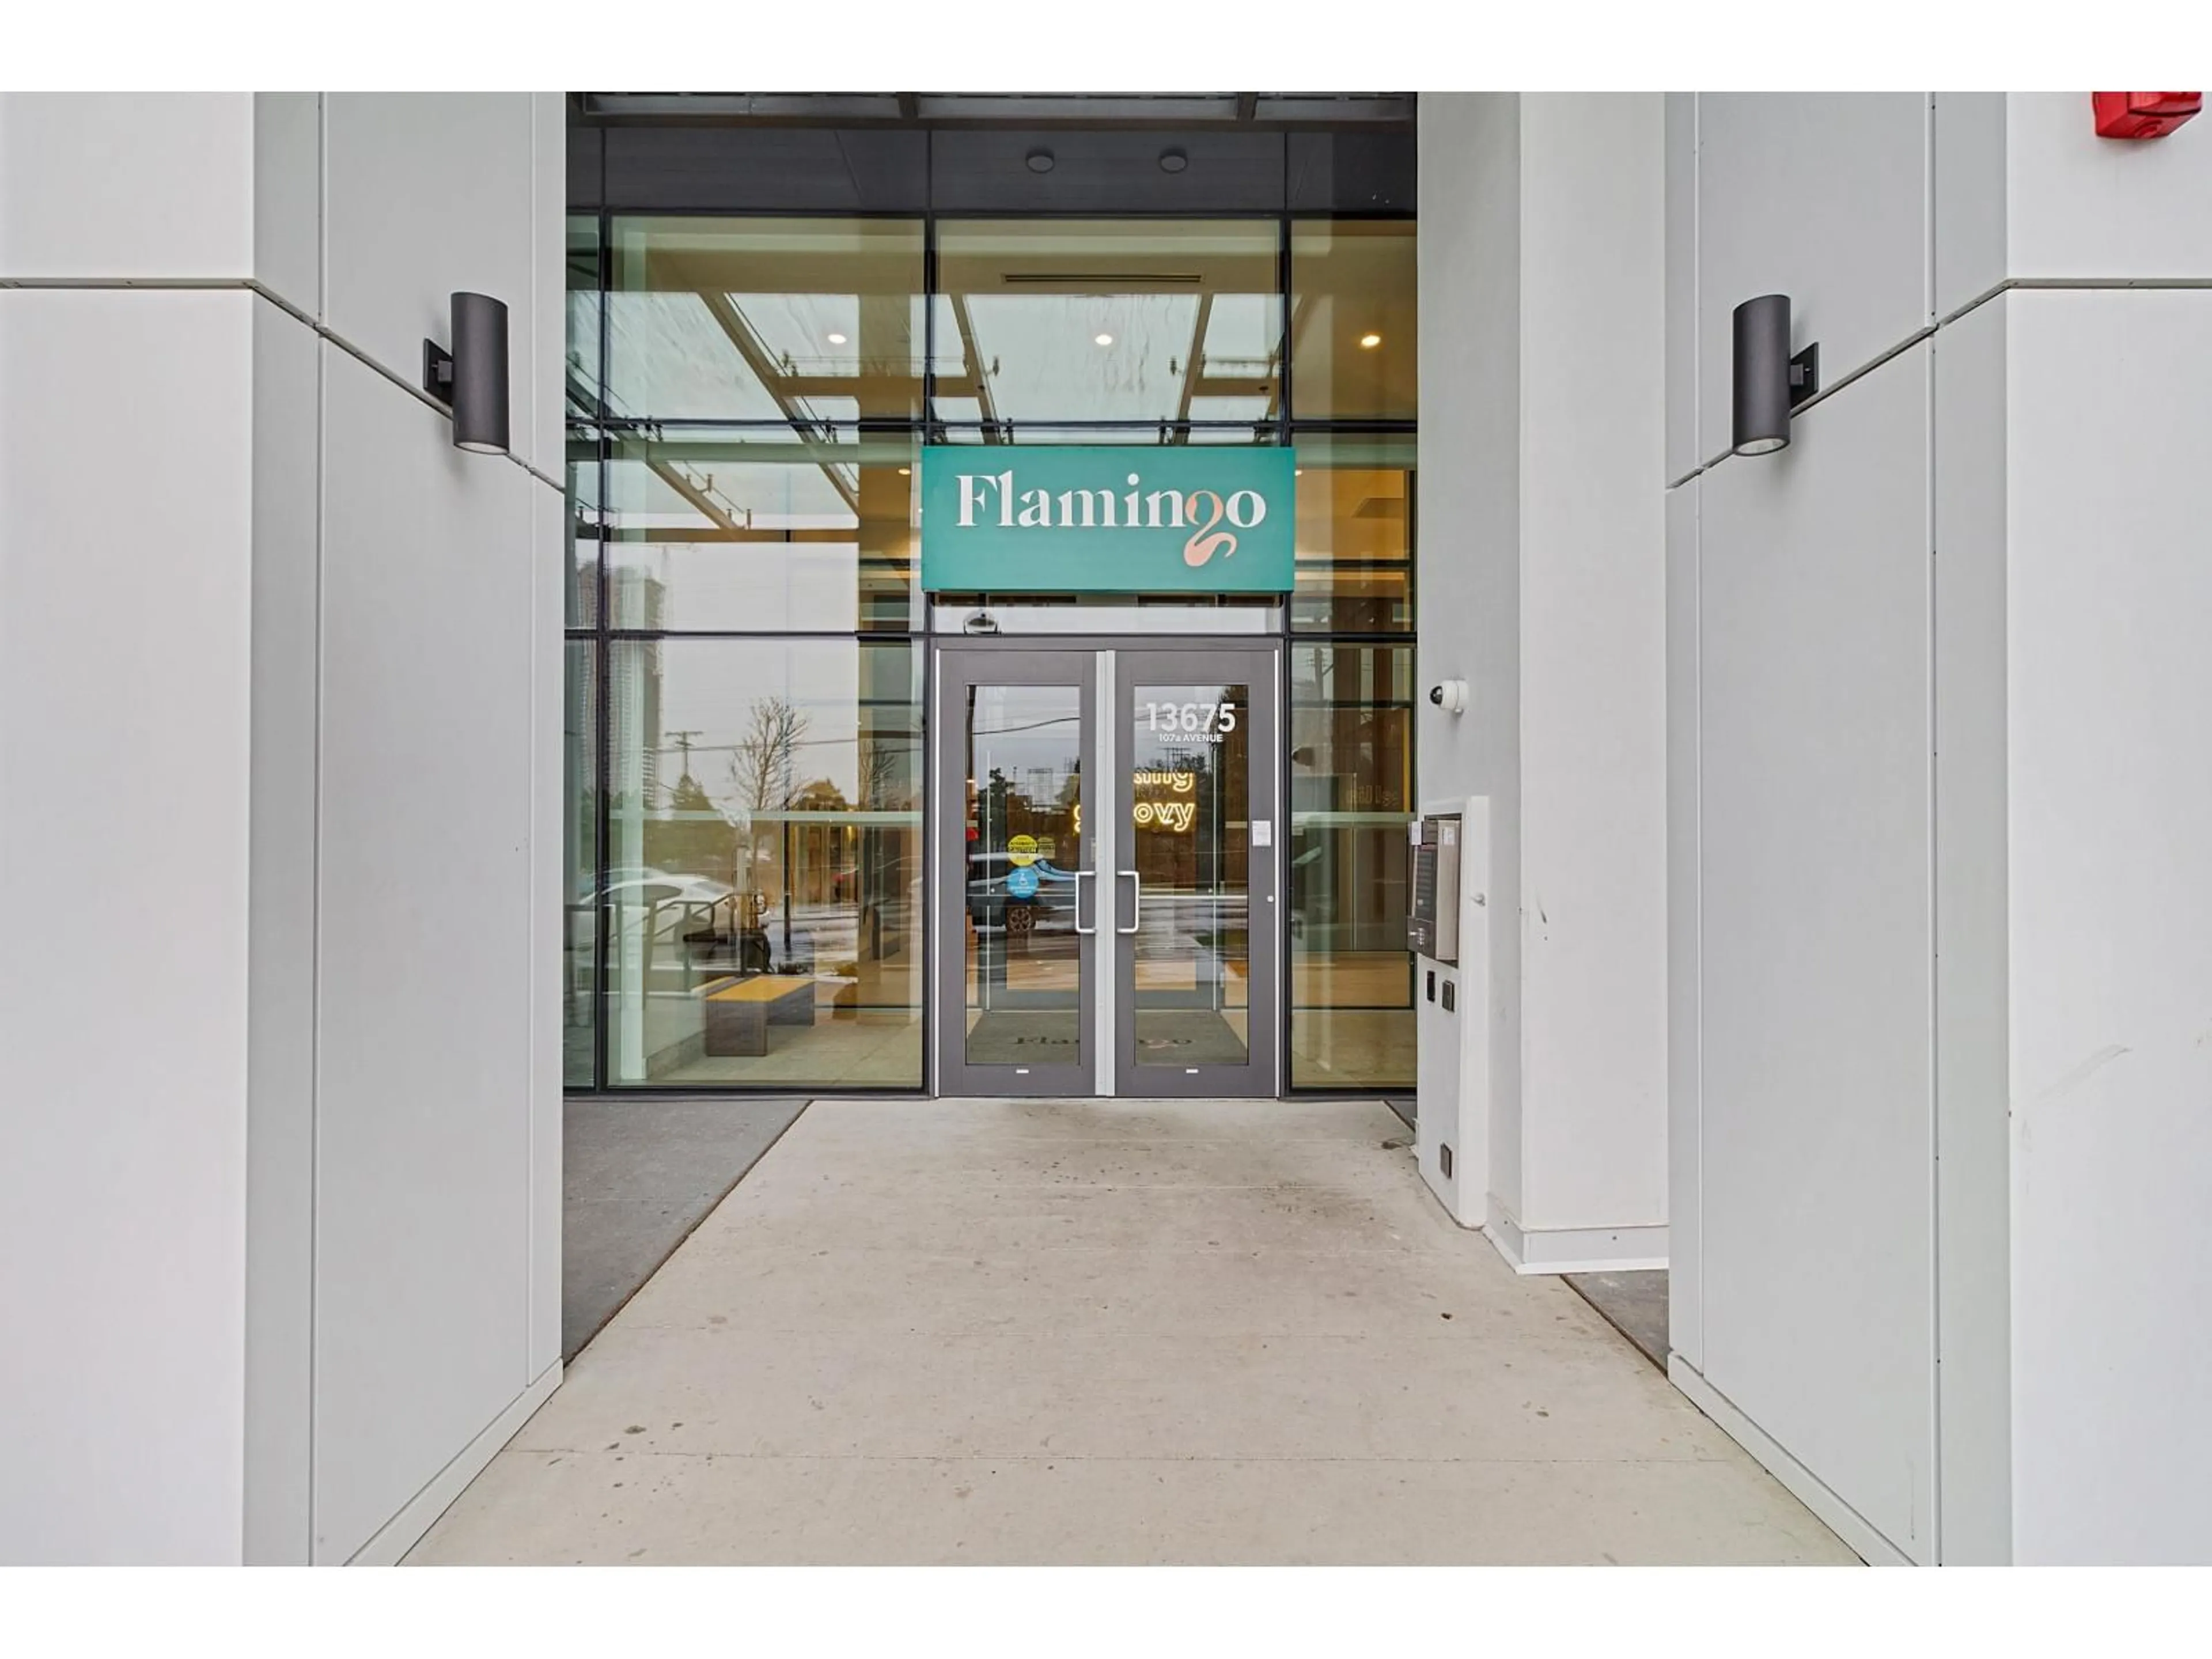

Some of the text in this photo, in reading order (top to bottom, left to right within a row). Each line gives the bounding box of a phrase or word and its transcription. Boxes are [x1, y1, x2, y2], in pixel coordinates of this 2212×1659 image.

[955, 470, 1266, 566] Flamingo
[1146, 702, 1236, 732] 13675
[1183, 733, 1223, 742] AVENUE
